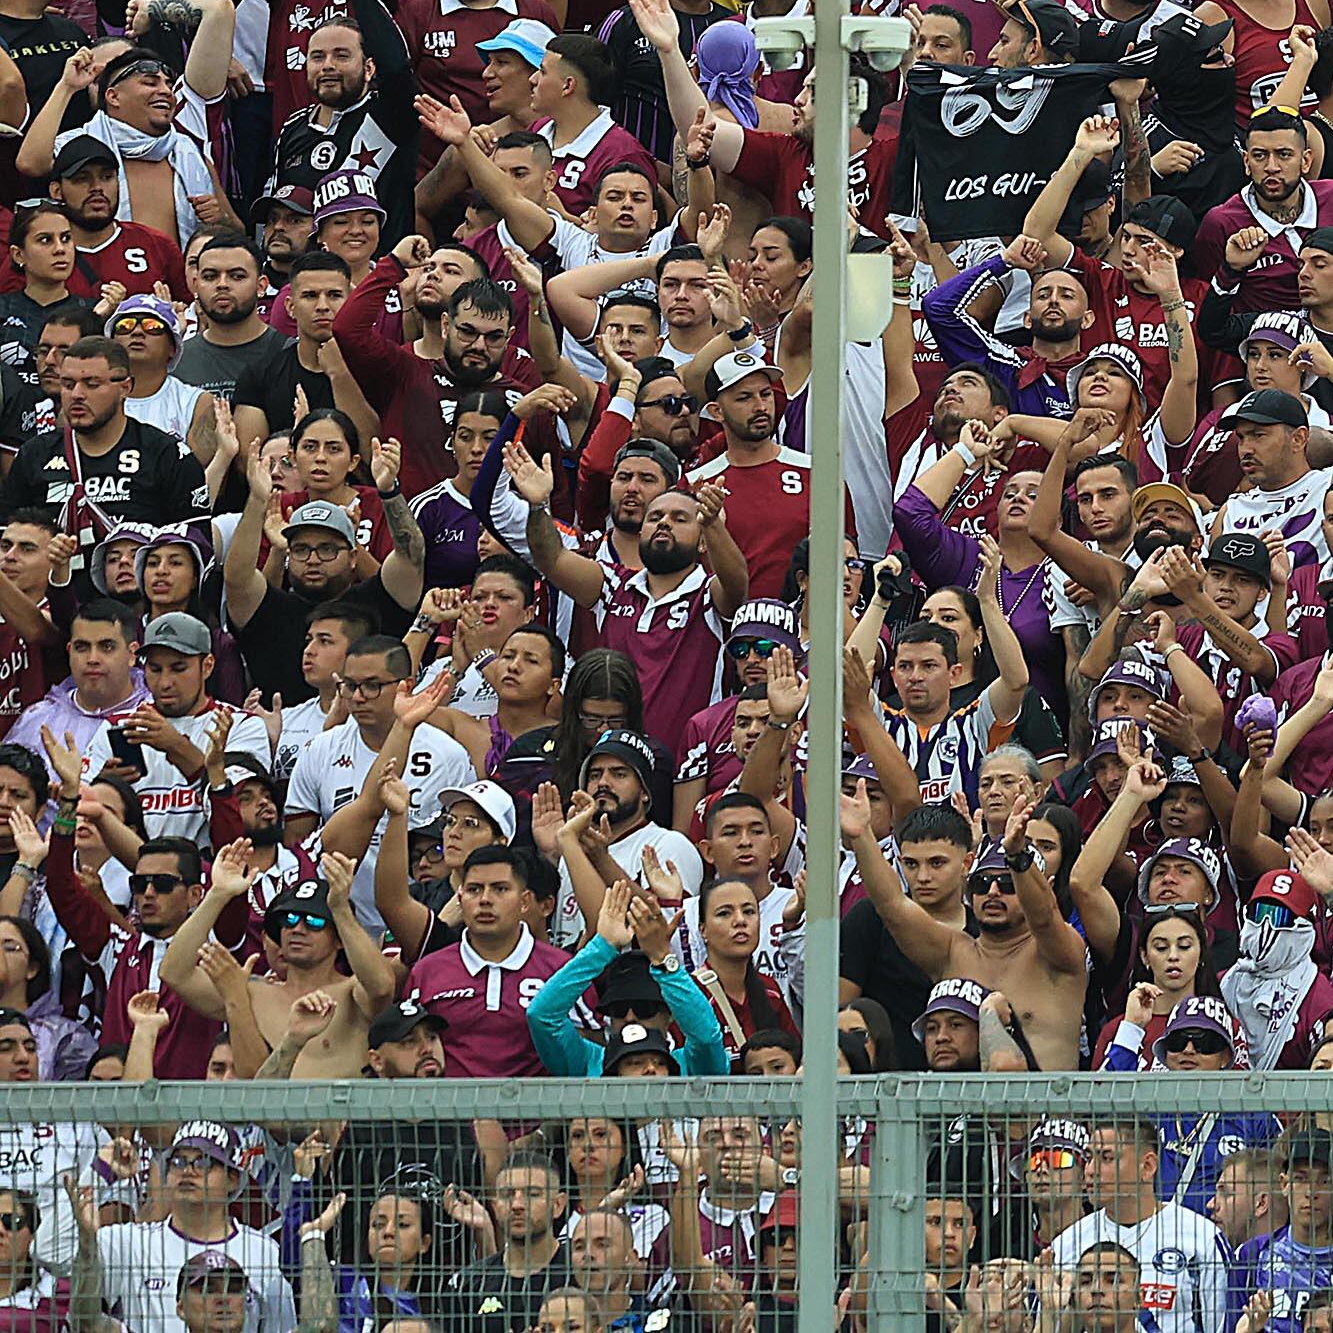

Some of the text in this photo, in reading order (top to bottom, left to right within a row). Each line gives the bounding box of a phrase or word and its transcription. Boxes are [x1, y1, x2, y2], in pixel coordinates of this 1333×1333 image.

[424, 31, 456, 49] UM
[434, 49, 450, 59] LS
[559, 163, 586, 190] S
[945, 172, 1045, 202] LOS GUI-
[322, 179, 350, 205] LOS
[128, 247, 149, 274] S
[1139, 323, 1169, 342] BA
[118, 450, 140, 473] S
[84, 479, 130, 497] BAC
[782, 471, 802, 493] S
[667, 601, 689, 629] S
[1121, 660, 1155, 683] SUR
[411, 752, 431, 776] S
[474, 784, 488, 793] S
[1272, 874, 1290, 895] S
[519, 979, 542, 1008] S
[400, 998, 417, 1015] S
